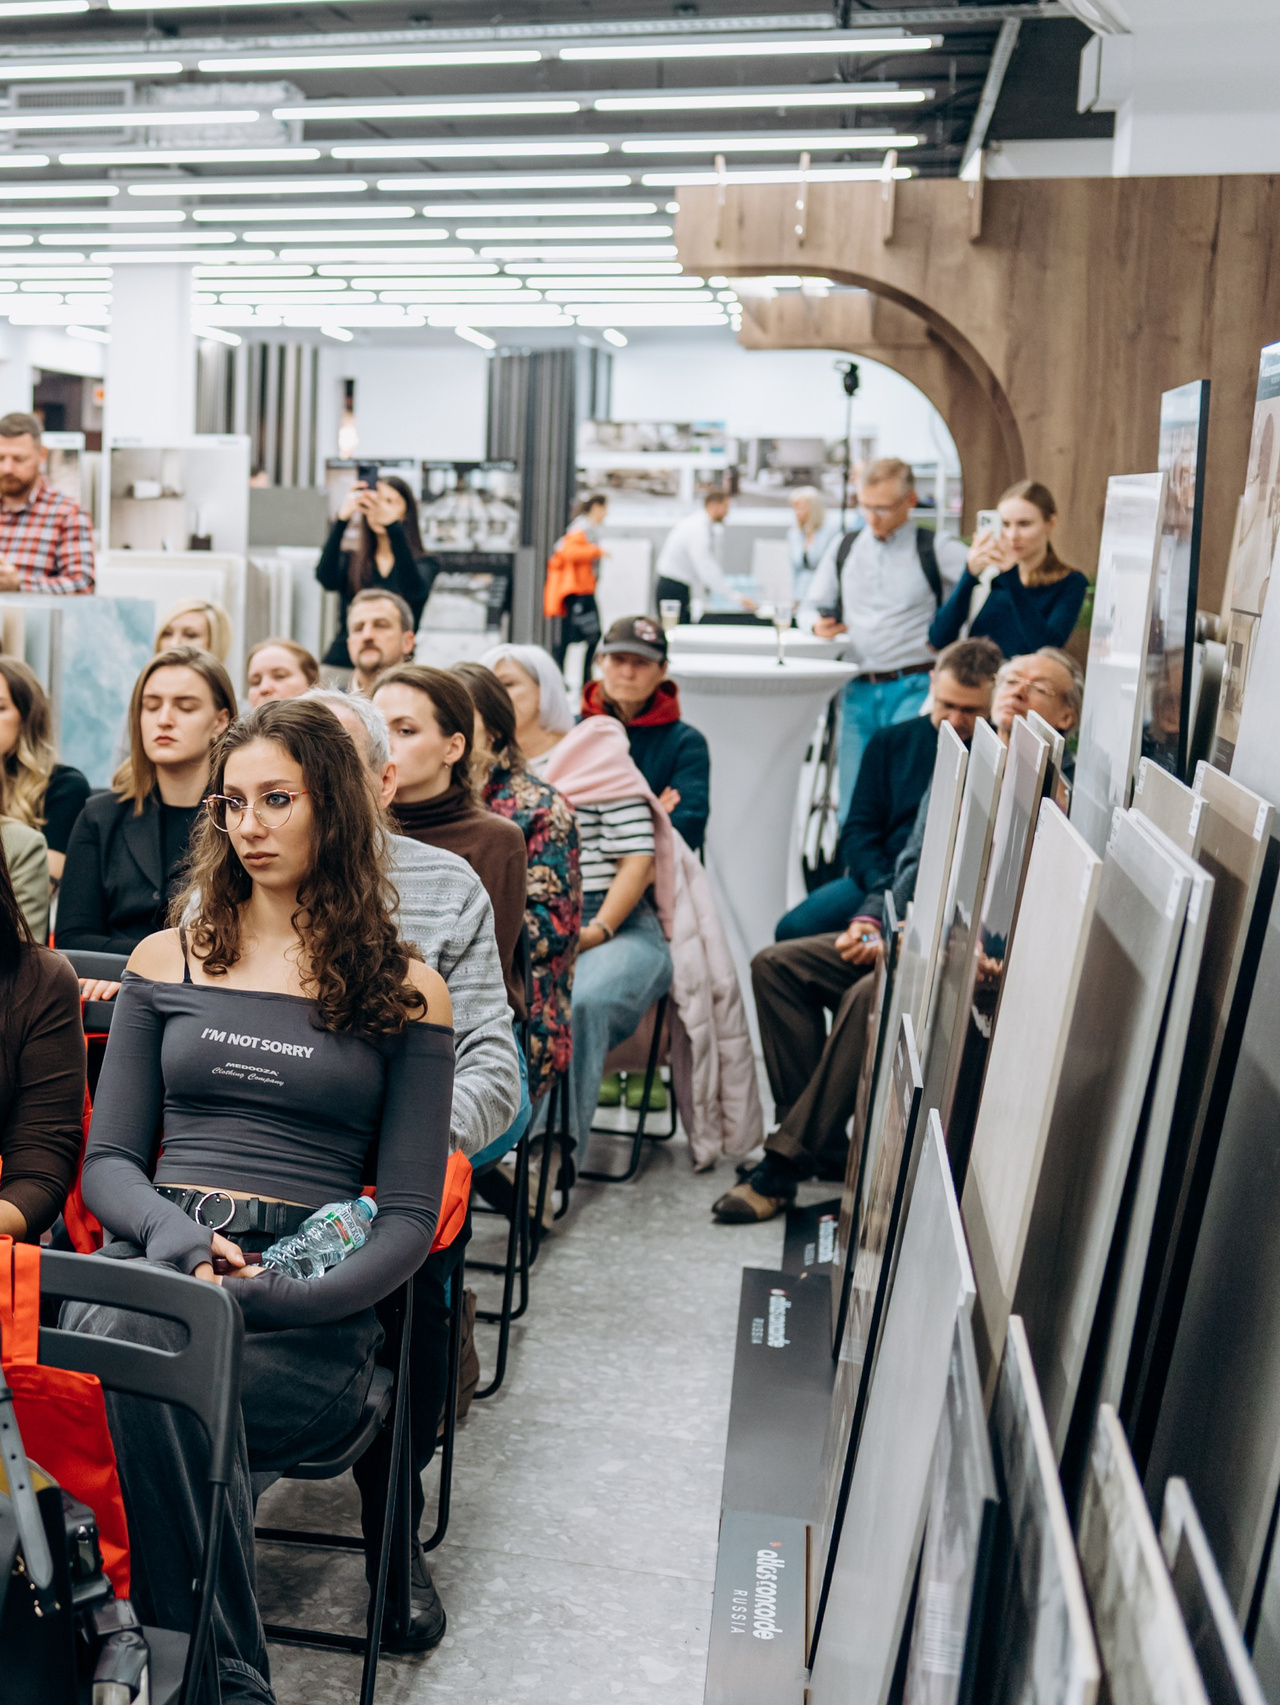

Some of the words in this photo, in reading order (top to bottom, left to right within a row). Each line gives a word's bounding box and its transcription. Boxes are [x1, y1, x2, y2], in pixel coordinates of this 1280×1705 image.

[201, 1028, 227, 1043] I'M
[227, 1033, 261, 1049] NOT
[260, 1039, 314, 1059] SORRY
[211, 1067, 245, 1079] Clothing
[247, 1073, 285, 1087] Company
[225, 1062, 278, 1076] MEDOOZA
[757, 1550, 785, 1580] atlas
[731, 1589, 748, 1633] RUSSIA
[753, 1580, 783, 1639] concorde
